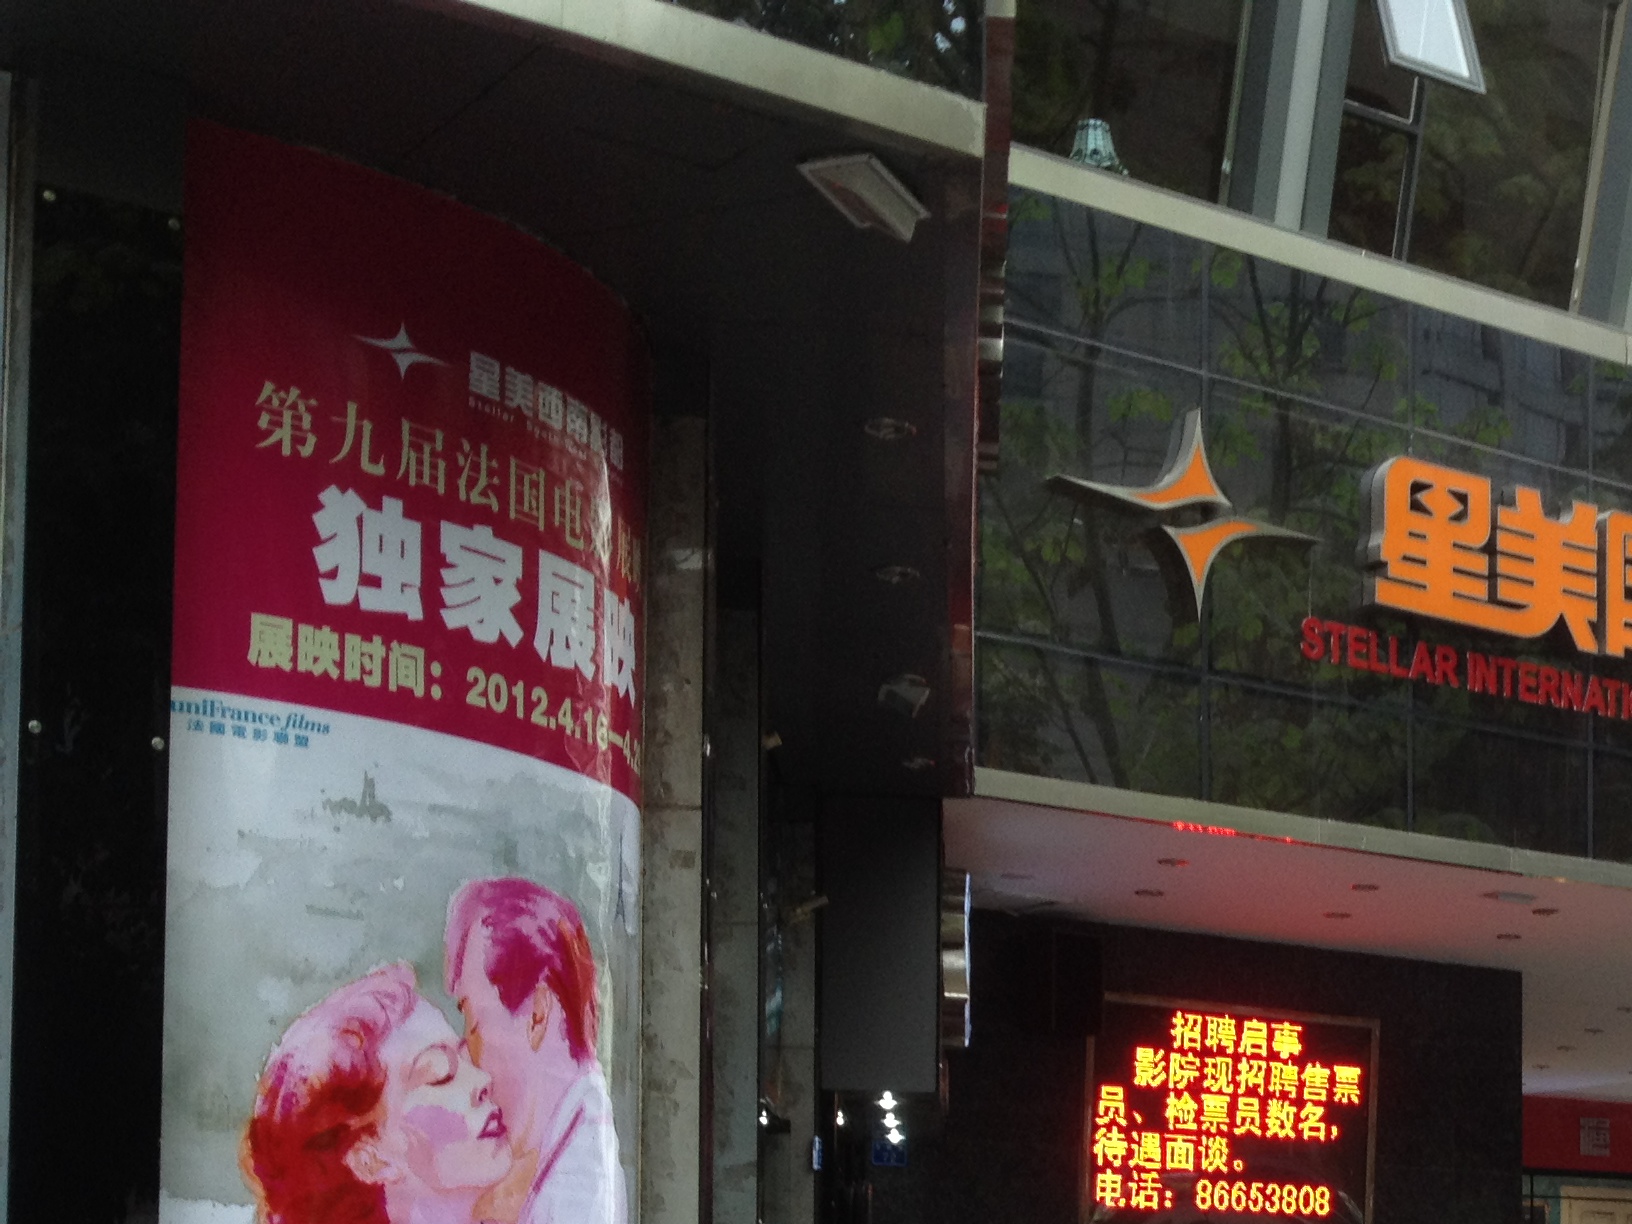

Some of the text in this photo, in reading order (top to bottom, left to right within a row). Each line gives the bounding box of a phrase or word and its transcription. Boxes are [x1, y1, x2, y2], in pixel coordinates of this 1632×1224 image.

[310, 484, 636, 707] 独家展映
[247, 612, 443, 700] 展映时间：
[1299, 615, 1459, 688] STELLAR
[281, 712, 330, 734] films
[1170, 1010, 1303, 1058] 招聘启事
[1133, 1046, 1362, 1105] 影院现招聘售票
[1093, 1126, 1246, 1173] 待遇面谈。
[1195, 1178, 1331, 1216] 86653808
